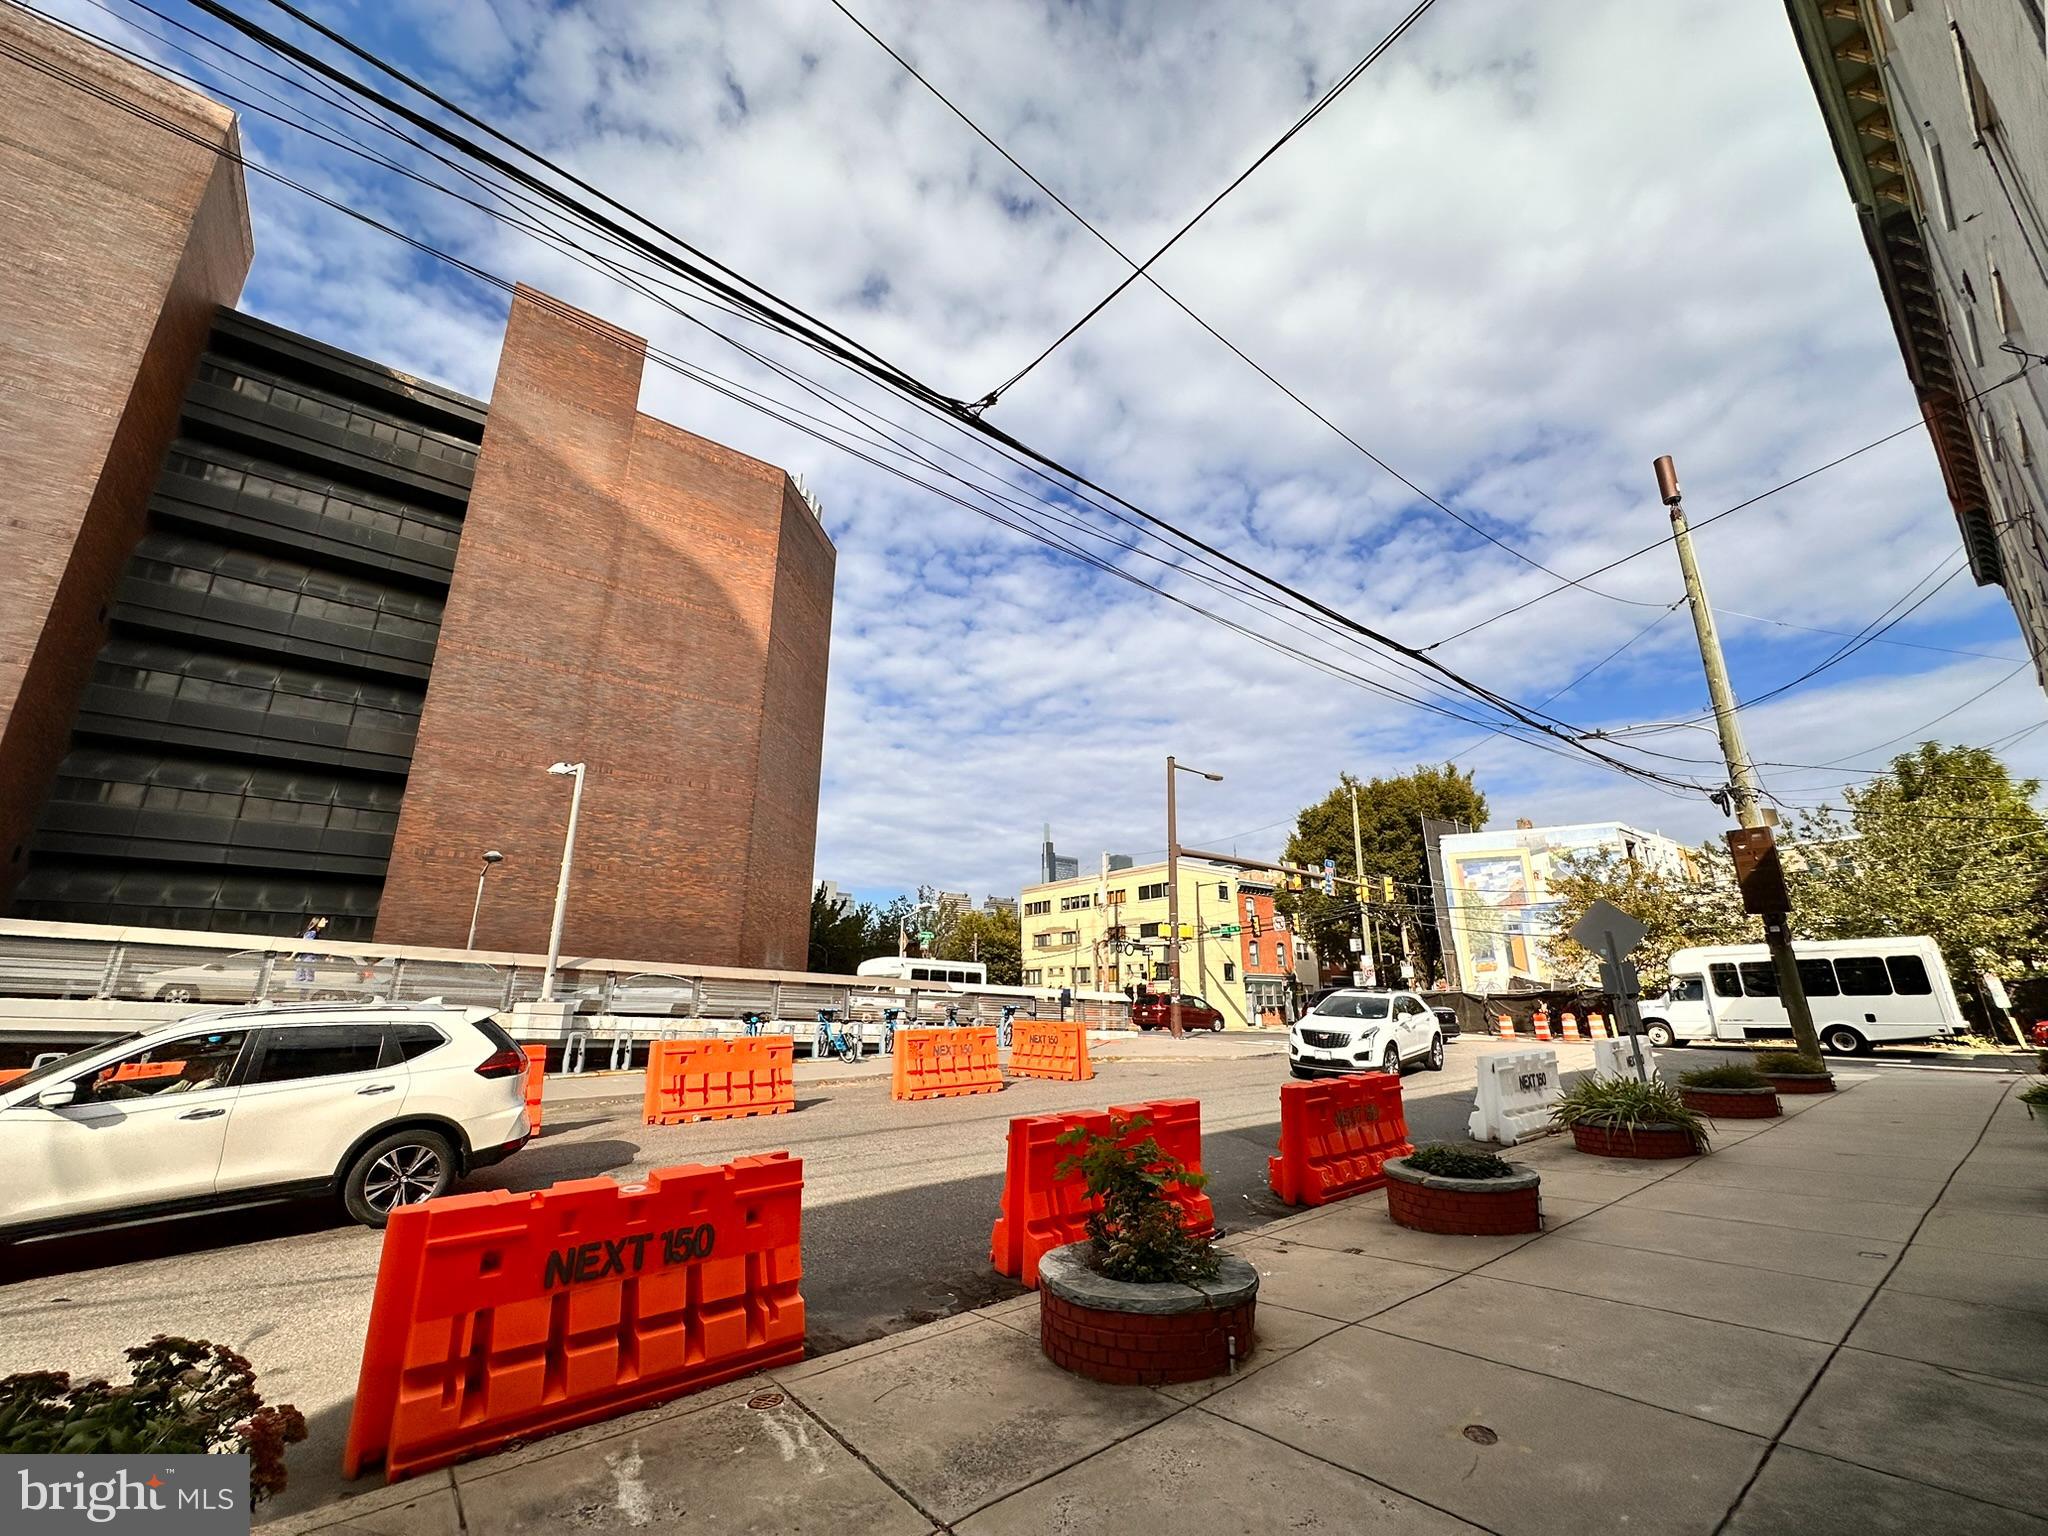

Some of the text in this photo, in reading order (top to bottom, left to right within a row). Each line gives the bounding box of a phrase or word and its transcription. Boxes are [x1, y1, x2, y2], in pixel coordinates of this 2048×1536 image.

[1029, 1033, 1059, 1045] NEXT 150
[933, 1043, 974, 1056] NEXT 150
[1519, 1072, 1547, 1091] NEXT 150
[544, 1223, 716, 1289] NEXT 150
